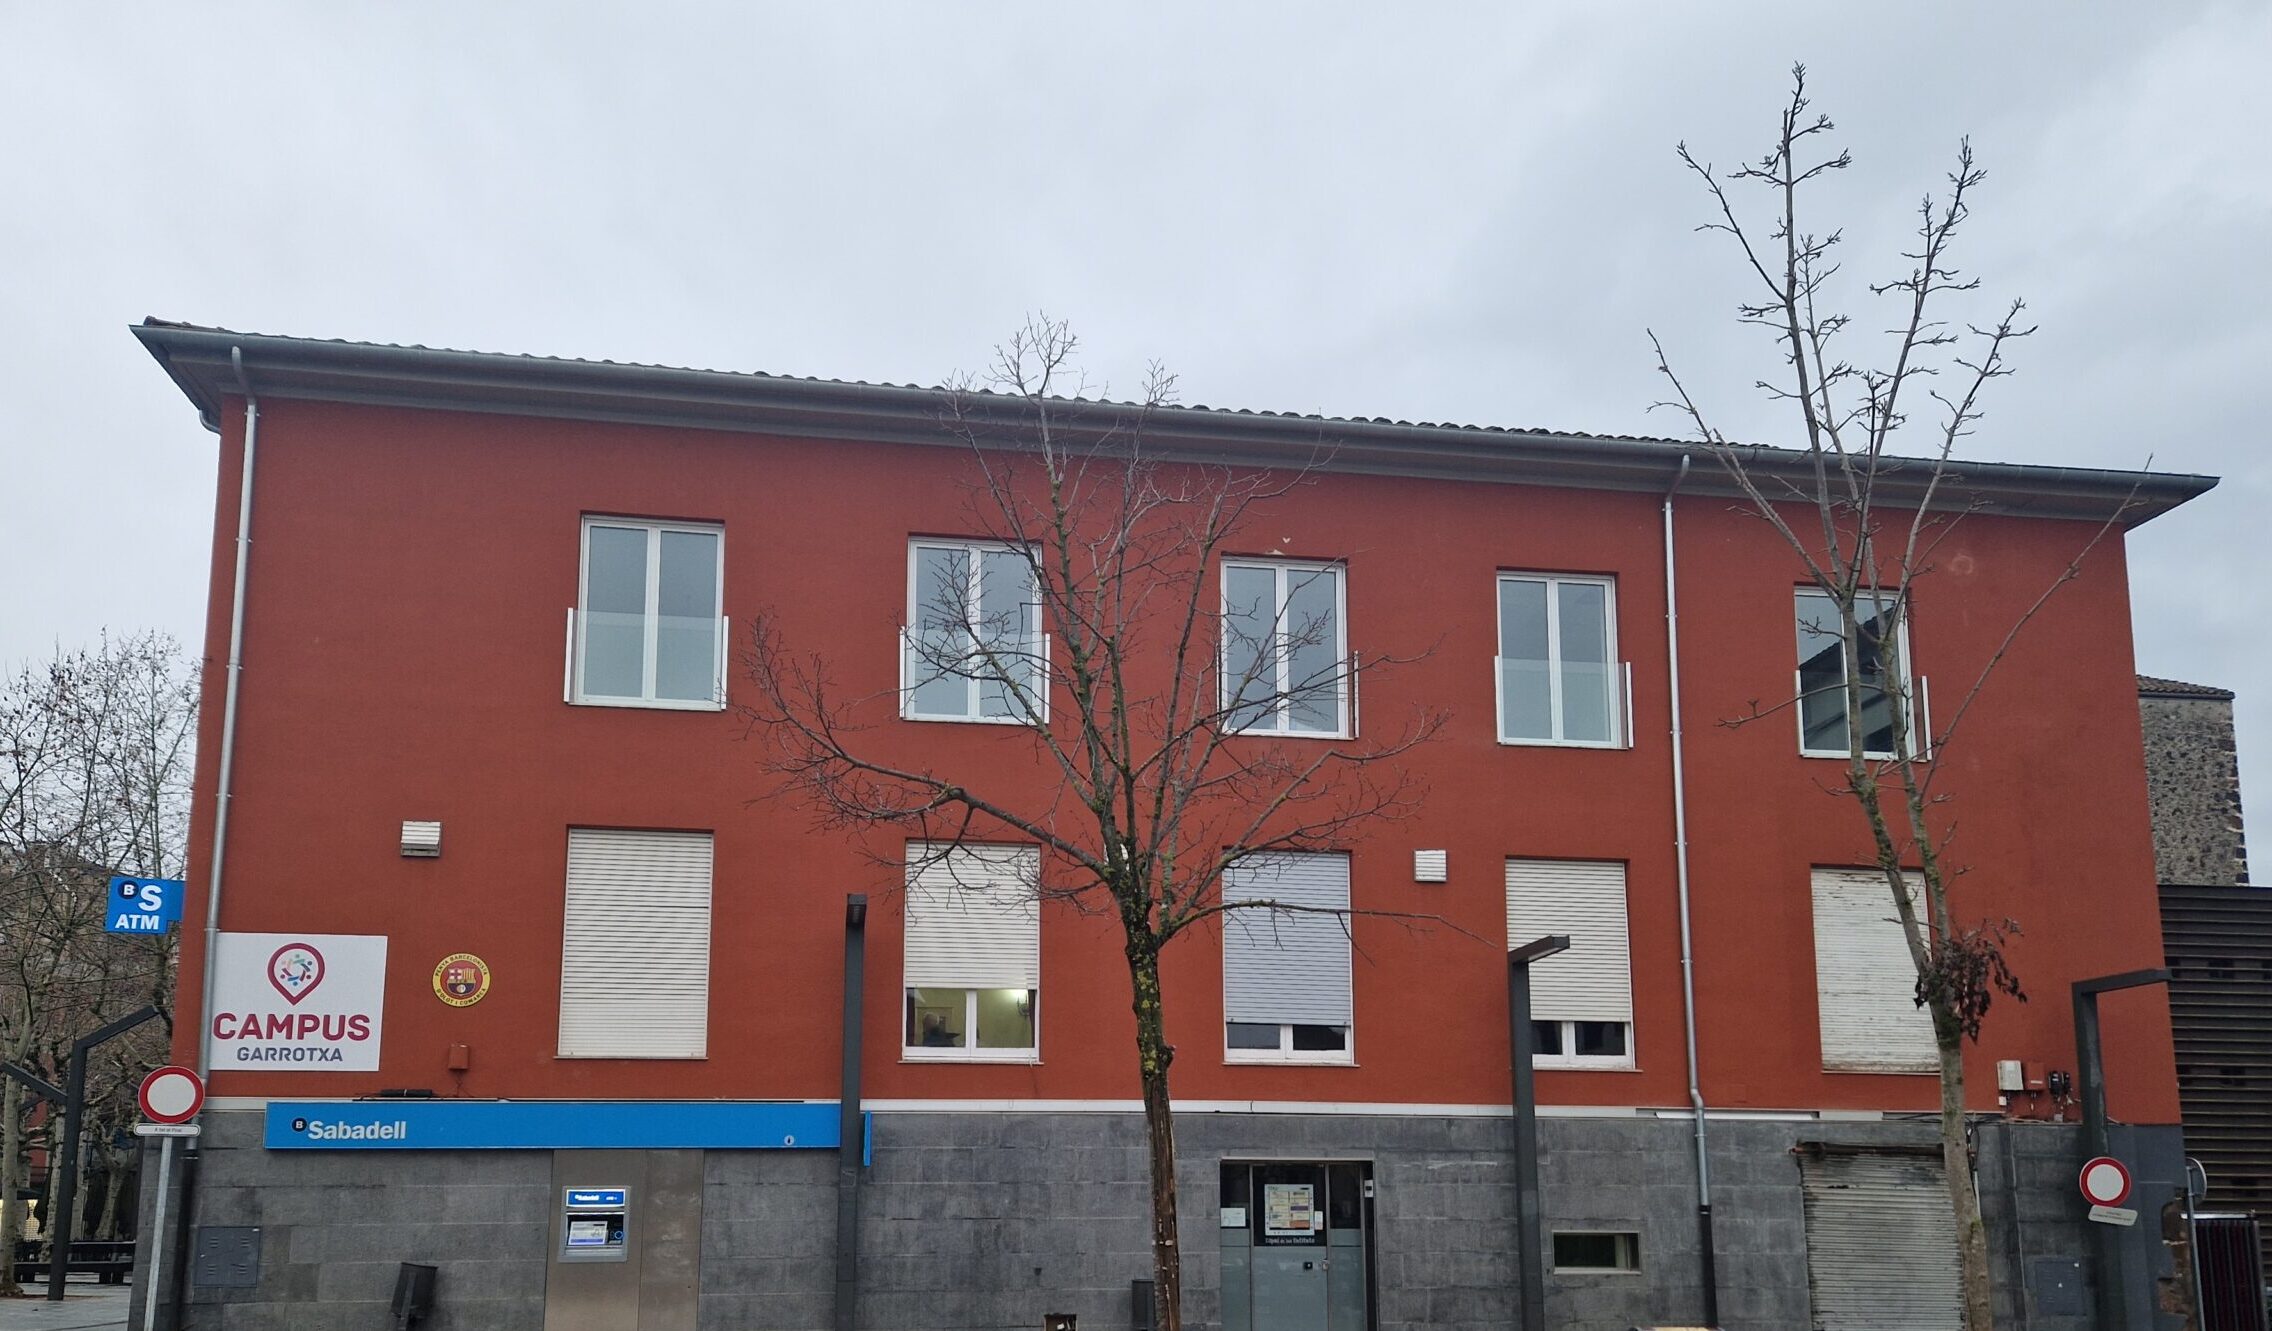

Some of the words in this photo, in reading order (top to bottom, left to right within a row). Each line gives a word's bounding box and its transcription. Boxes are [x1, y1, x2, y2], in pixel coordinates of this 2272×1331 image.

[138, 884, 162, 912] S
[115, 914, 160, 930] ATM
[213, 1012, 371, 1041] CAMPUS
[236, 1046, 344, 1062] GARROTXA
[307, 1120, 407, 1140] Sabadell
